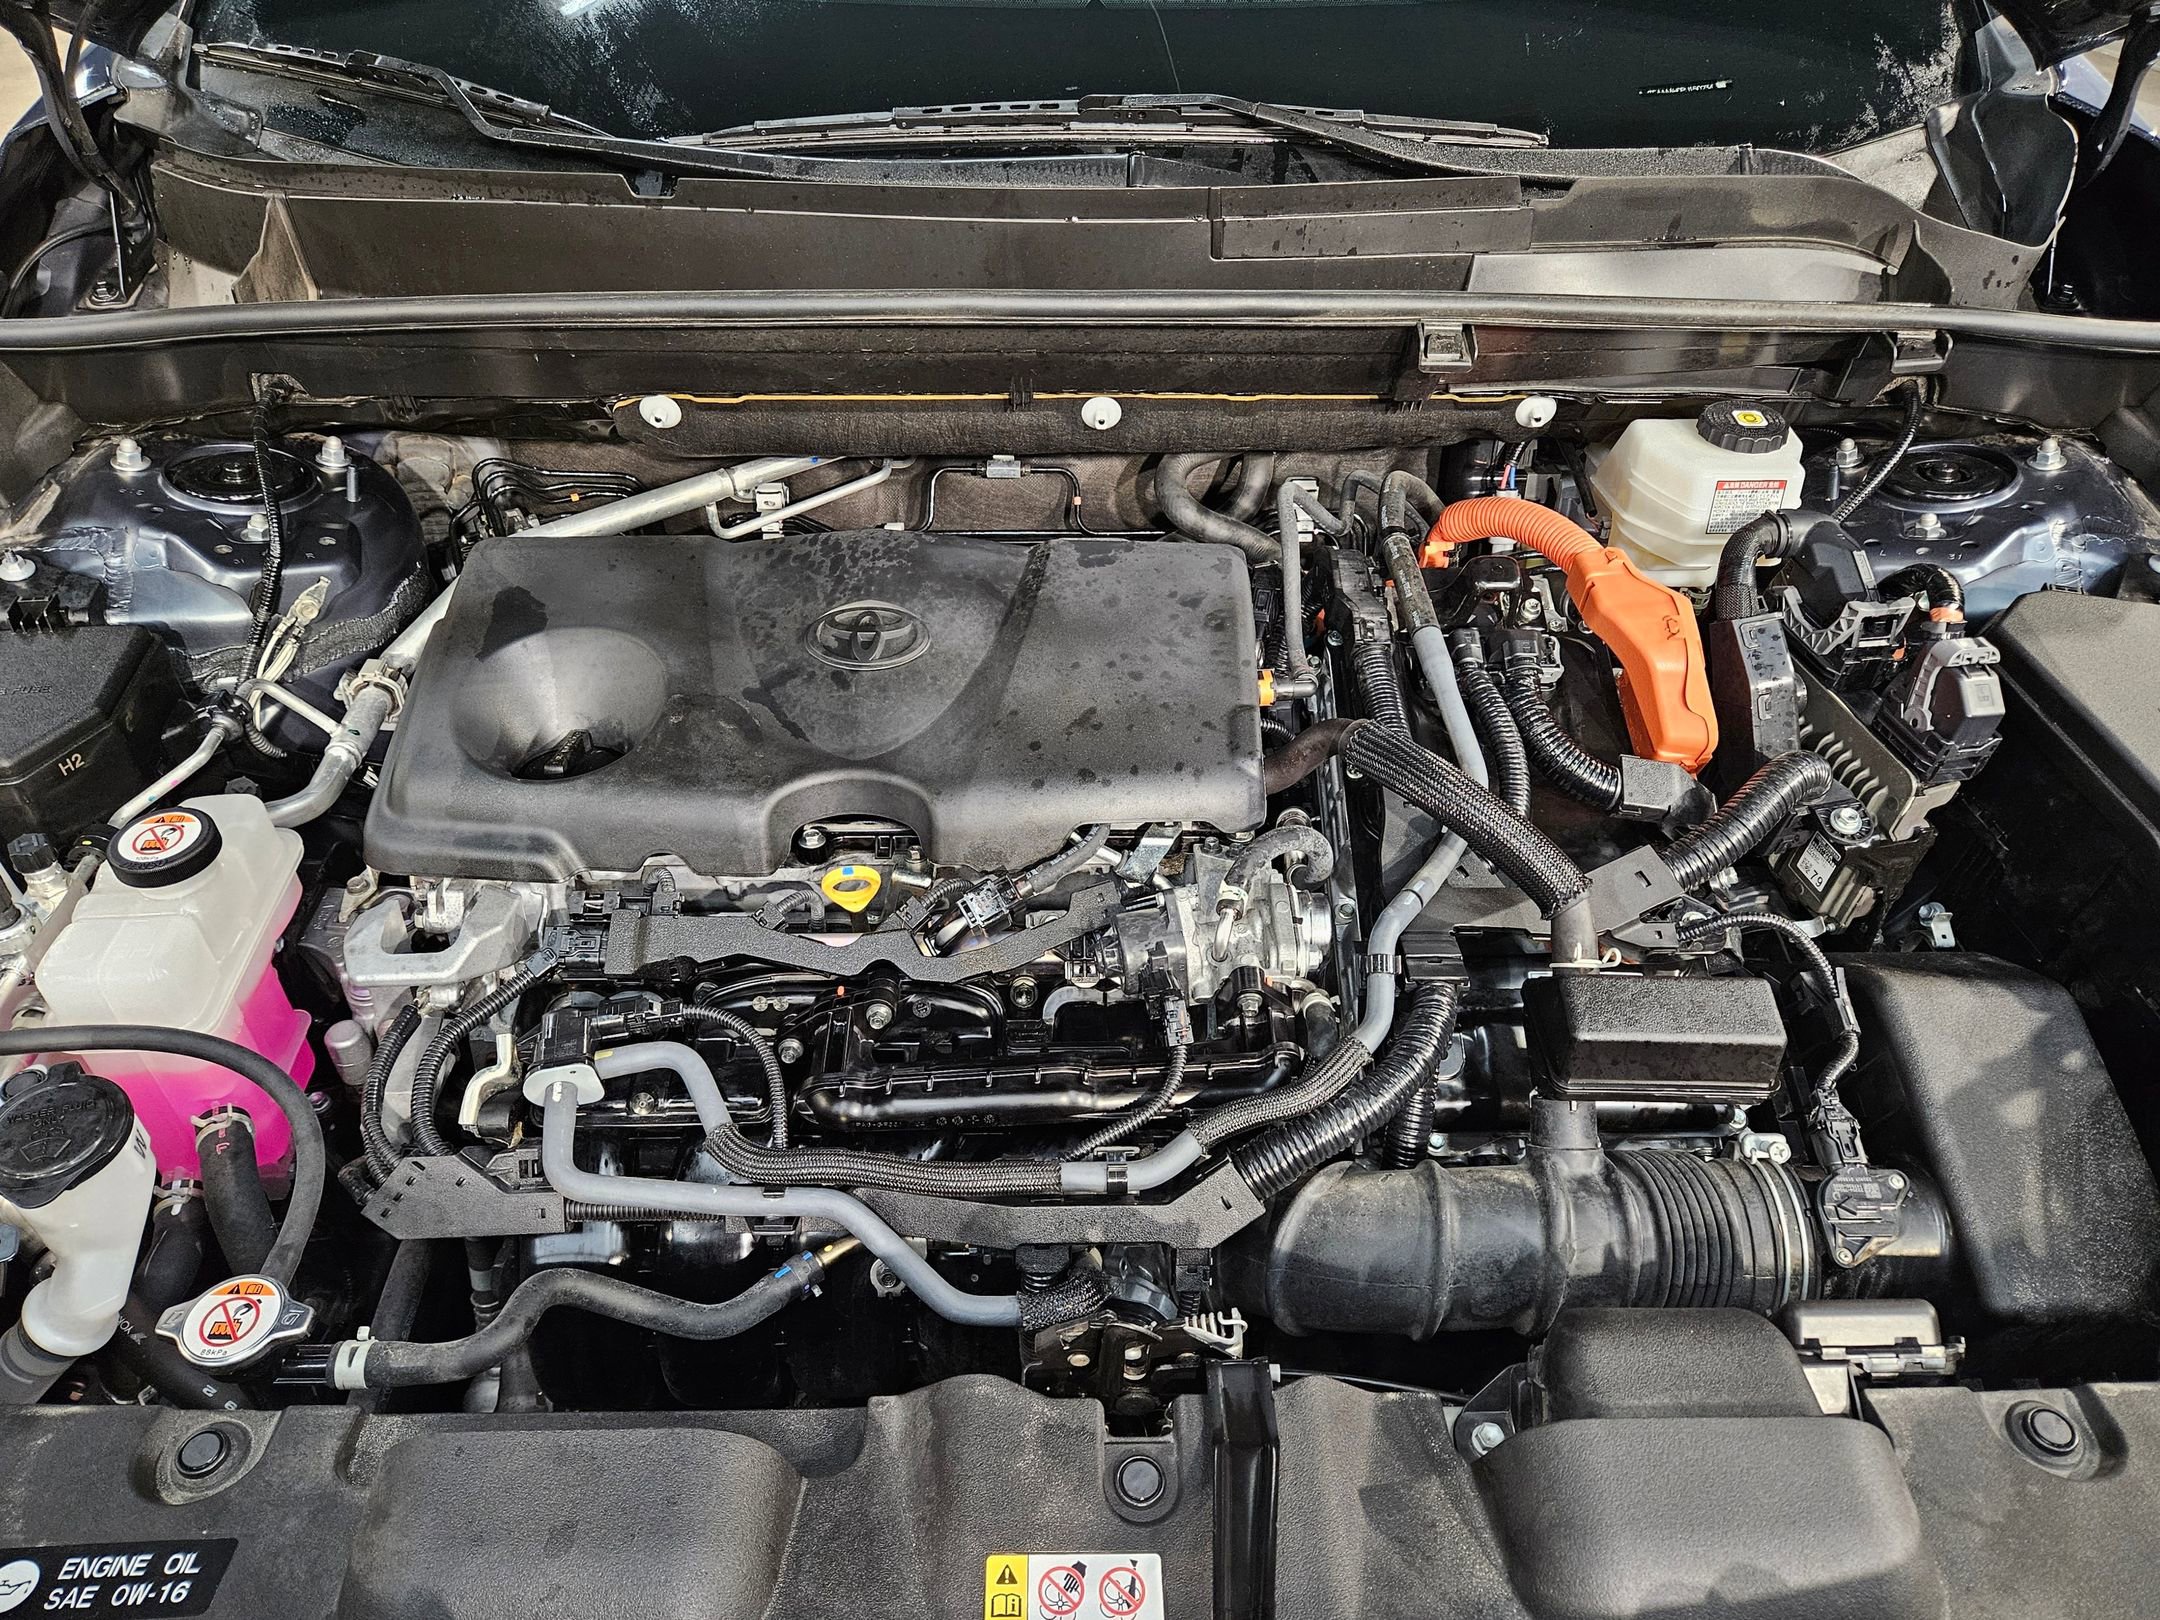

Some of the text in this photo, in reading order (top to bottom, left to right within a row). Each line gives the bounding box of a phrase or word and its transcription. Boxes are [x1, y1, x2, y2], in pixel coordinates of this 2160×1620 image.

[1739, 481, 1769, 489] DANGER
[58, 753, 85, 776] H2
[1810, 869, 1823, 887] 79
[7, 1100, 97, 1124] WASHER FLUID
[33, 1115, 65, 1127] ONLY
[57, 1551, 202, 1580] ENGINE OIL
[43, 1580, 193, 1610] SAE 0W-16
